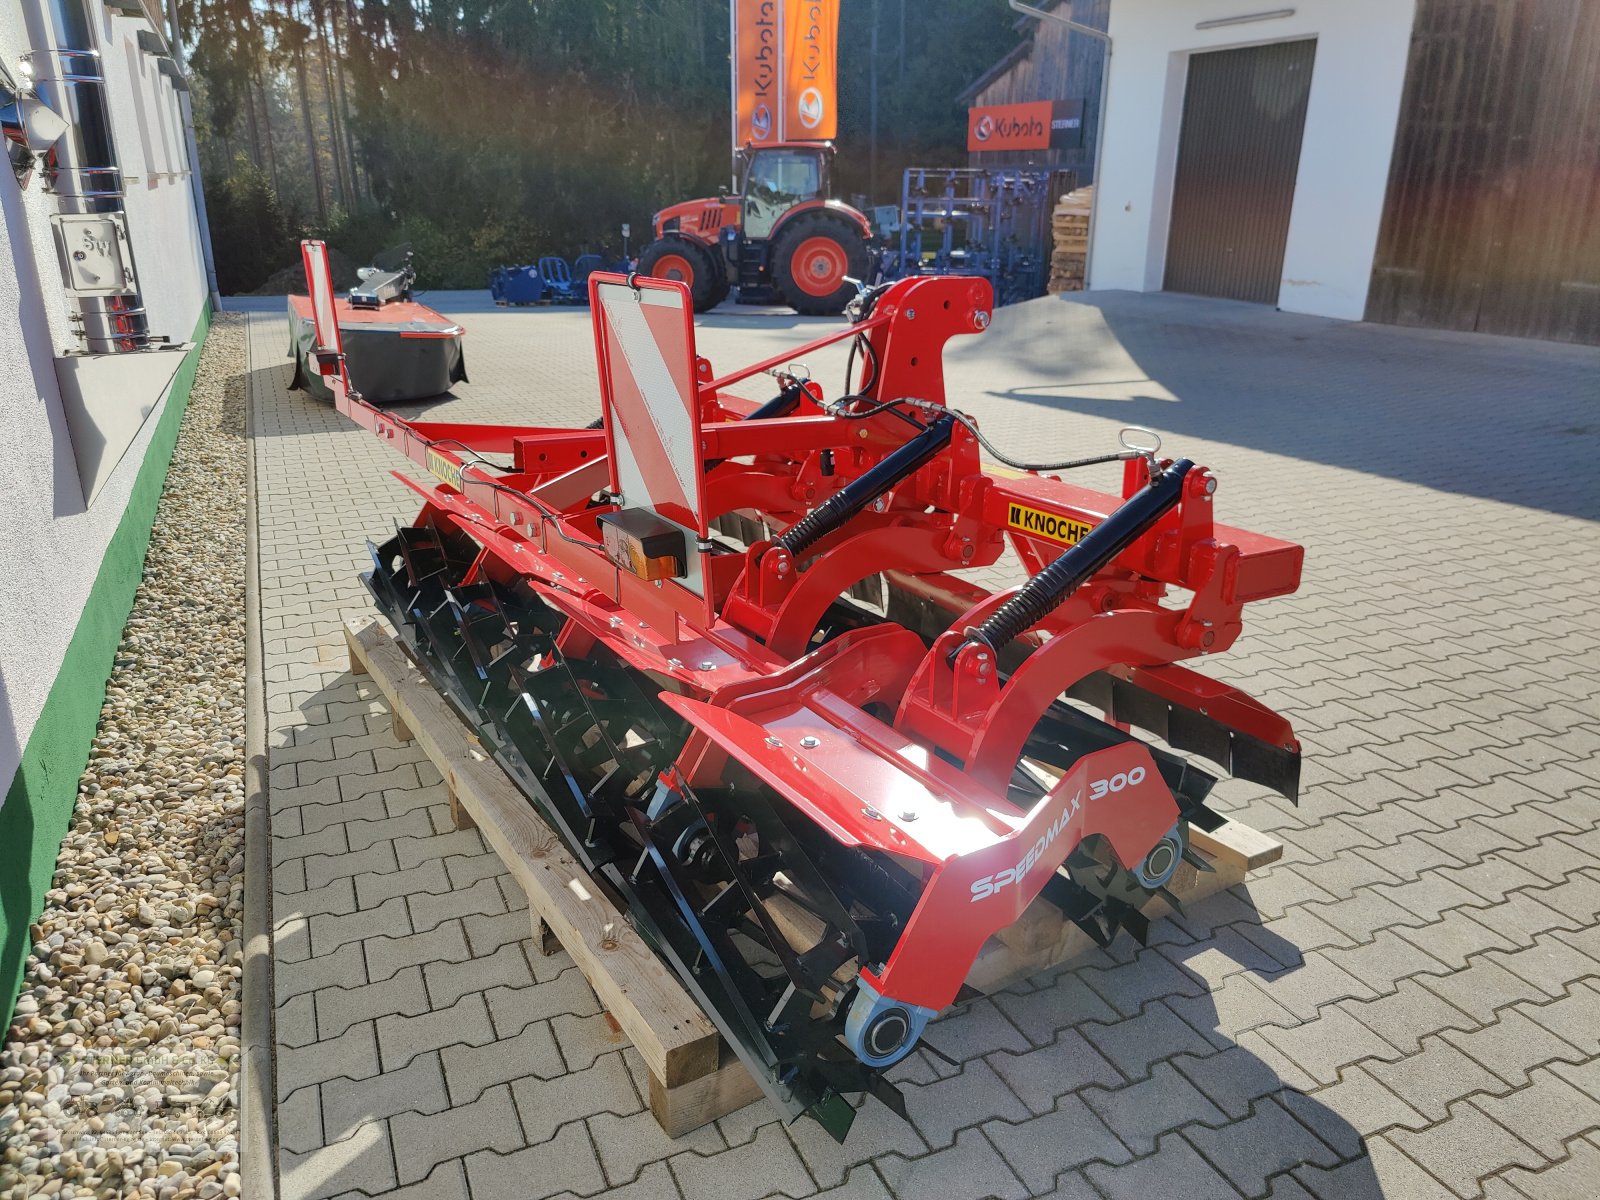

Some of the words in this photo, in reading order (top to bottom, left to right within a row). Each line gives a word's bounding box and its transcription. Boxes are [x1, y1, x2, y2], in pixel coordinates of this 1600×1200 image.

[754, 1, 774, 96] Kubota
[803, 0, 822, 80] Kubo
[995, 116, 1043, 137] Kubota
[970, 790, 1081, 903] SPEEDMAX
[1089, 766, 1146, 800] 300
